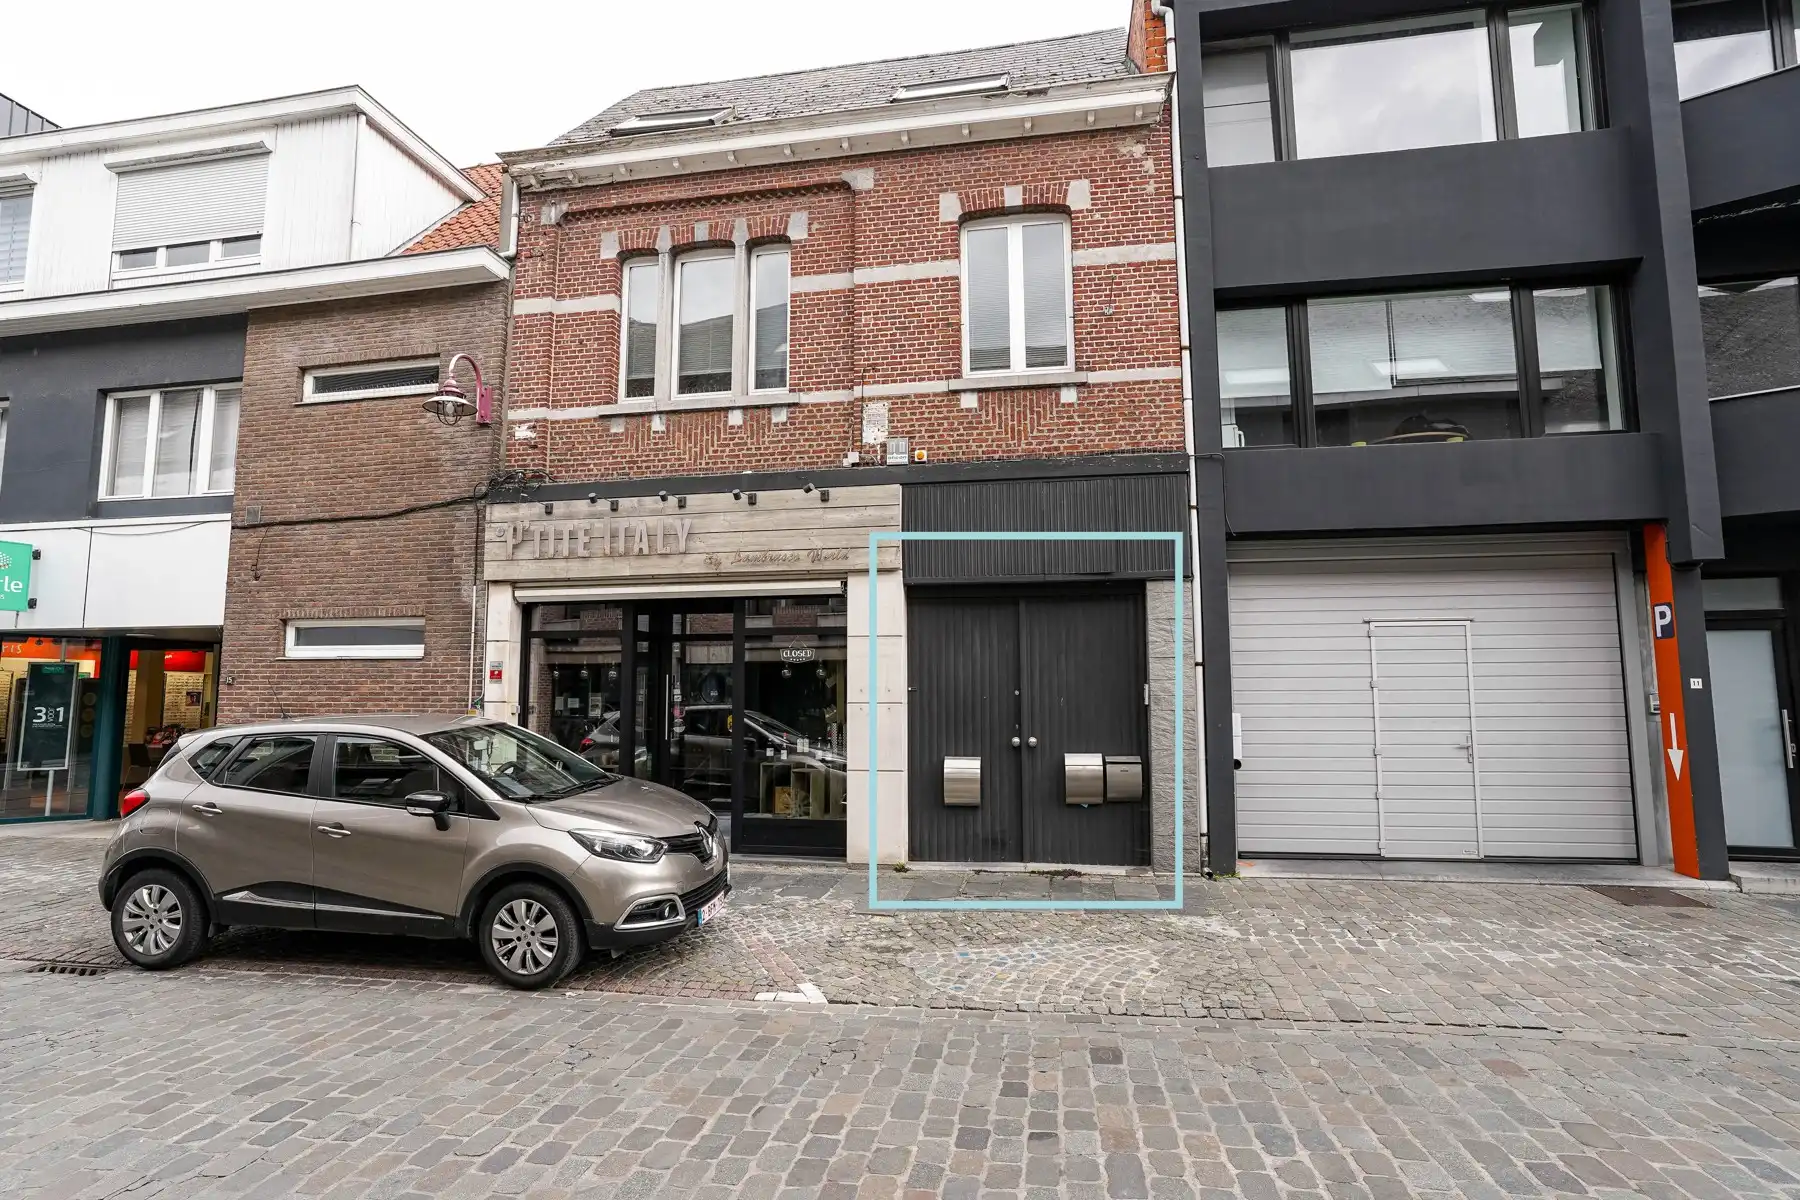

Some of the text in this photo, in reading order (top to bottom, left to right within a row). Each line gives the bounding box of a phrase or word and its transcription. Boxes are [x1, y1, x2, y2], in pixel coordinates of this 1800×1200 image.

[603, 517, 692, 556] ITALY
[1654, 605, 1672, 637] P
[783, 649, 812, 658] CLOSED
[226, 676, 233, 684] 15
[32, 706, 47, 723] 3
[56, 706, 64, 722] 1
